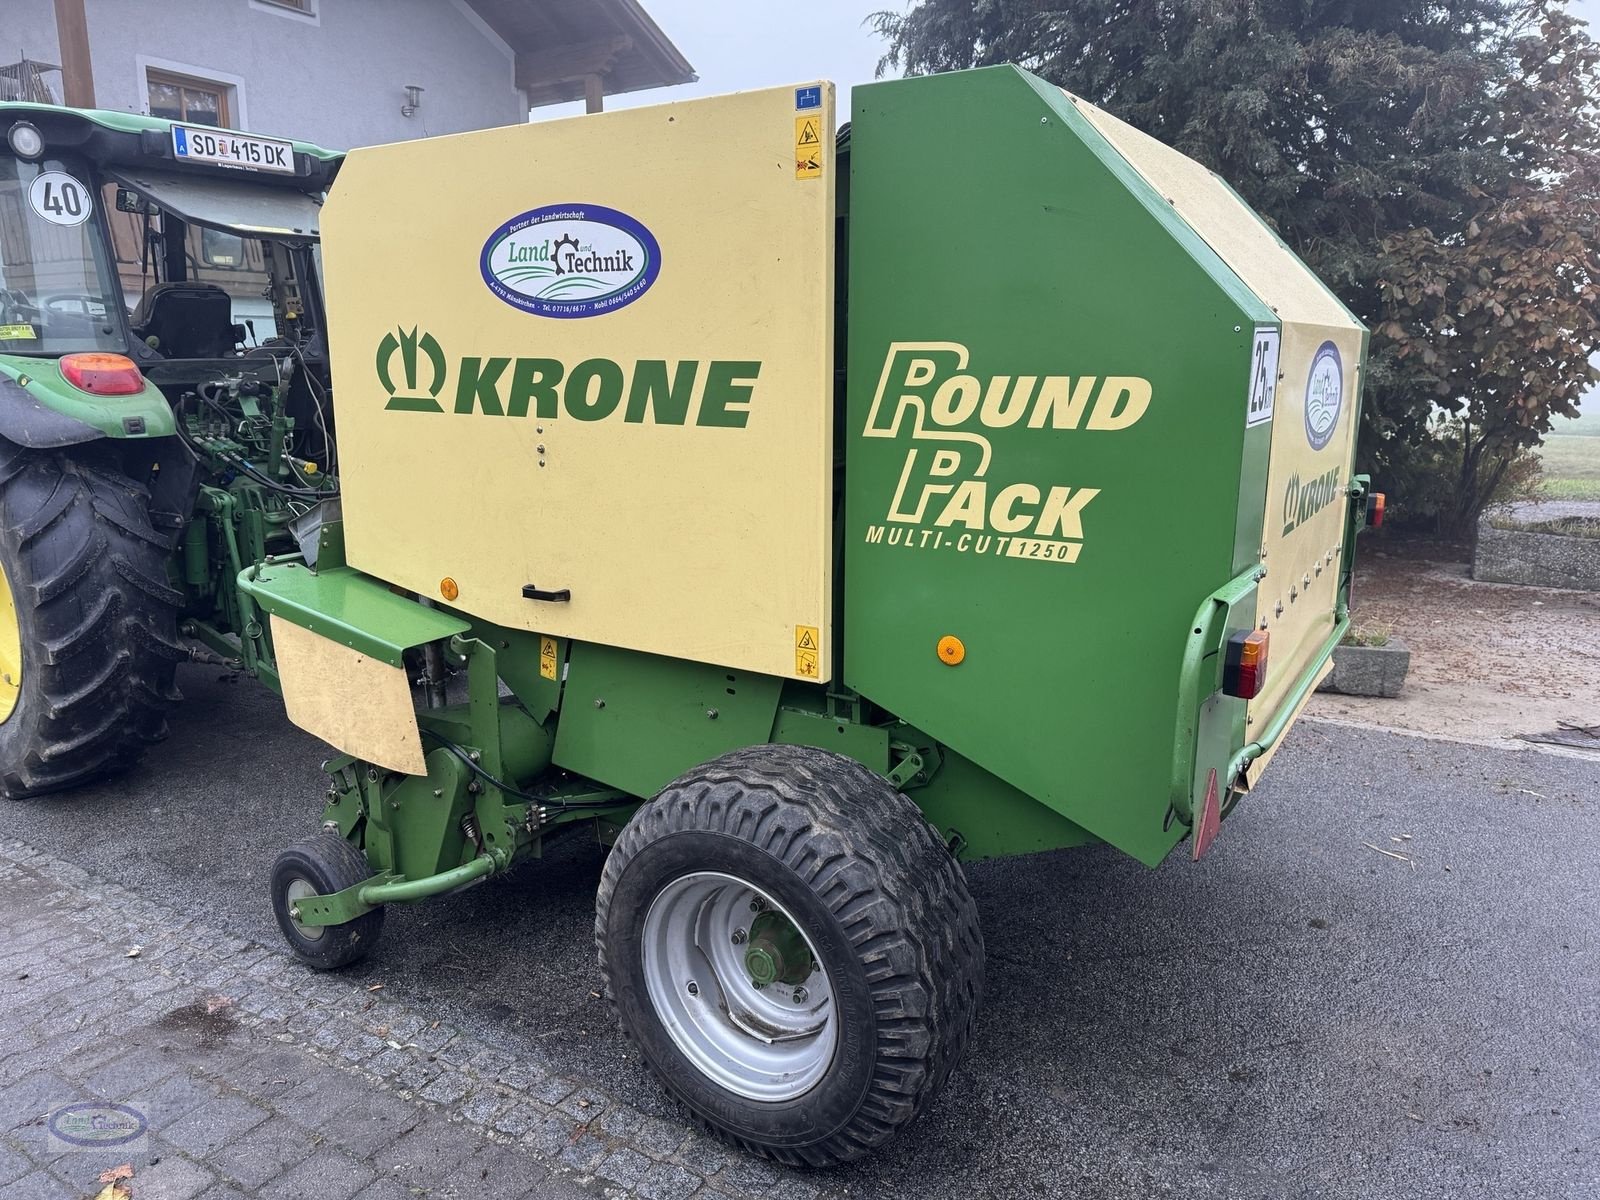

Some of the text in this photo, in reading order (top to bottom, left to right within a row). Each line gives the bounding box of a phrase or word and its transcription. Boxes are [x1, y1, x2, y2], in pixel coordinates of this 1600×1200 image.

[192, 135, 216, 156] SD
[231, 140, 260, 162] 415
[264, 145, 286, 167] DK
[44, 182, 82, 216] 40
[510, 211, 585, 233] Partner der Landwirtschaft
[508, 239, 550, 262] Land
[565, 250, 634, 274] Technik
[580, 244, 592, 252] und
[594, 300, 608, 310] Mobil
[454, 356, 762, 428] KRONE
[862, 341, 1152, 438] ROUND
[1251, 340, 1269, 412] 25
[886, 434, 1102, 539] PACK
[1296, 466, 1340, 528] KRONE
[865, 525, 1068, 560] MULTI-CUT 1250
